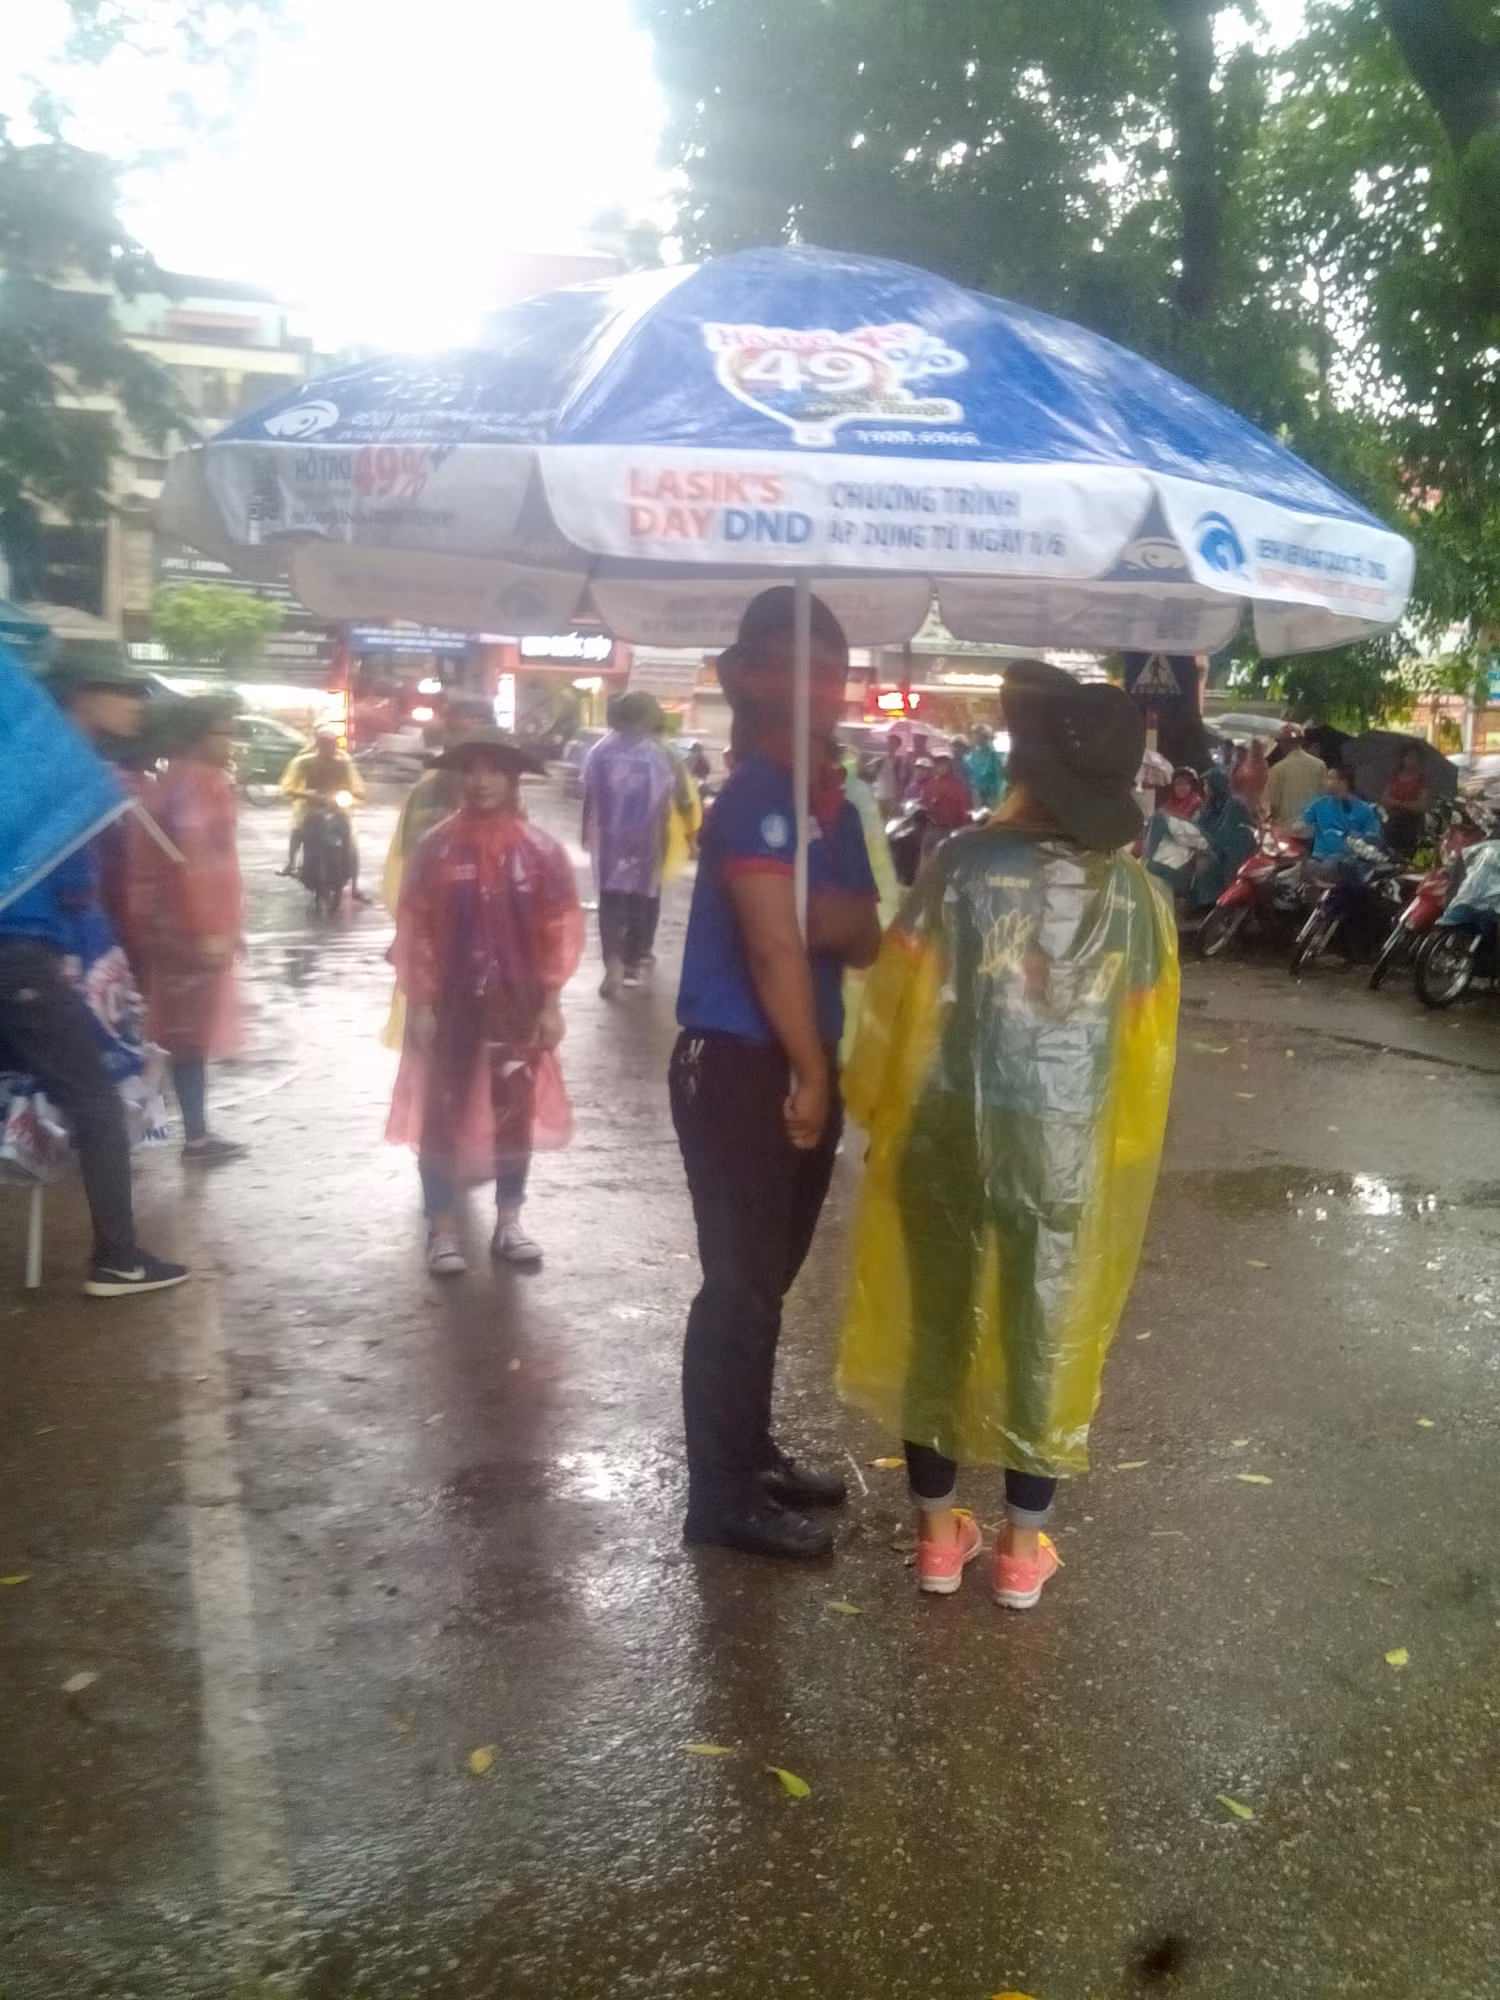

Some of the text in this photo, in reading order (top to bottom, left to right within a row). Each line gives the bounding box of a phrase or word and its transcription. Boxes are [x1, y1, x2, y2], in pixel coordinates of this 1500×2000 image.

[629, 467, 783, 504] LASIK'S
[629, 506, 814, 543] DAY DND
